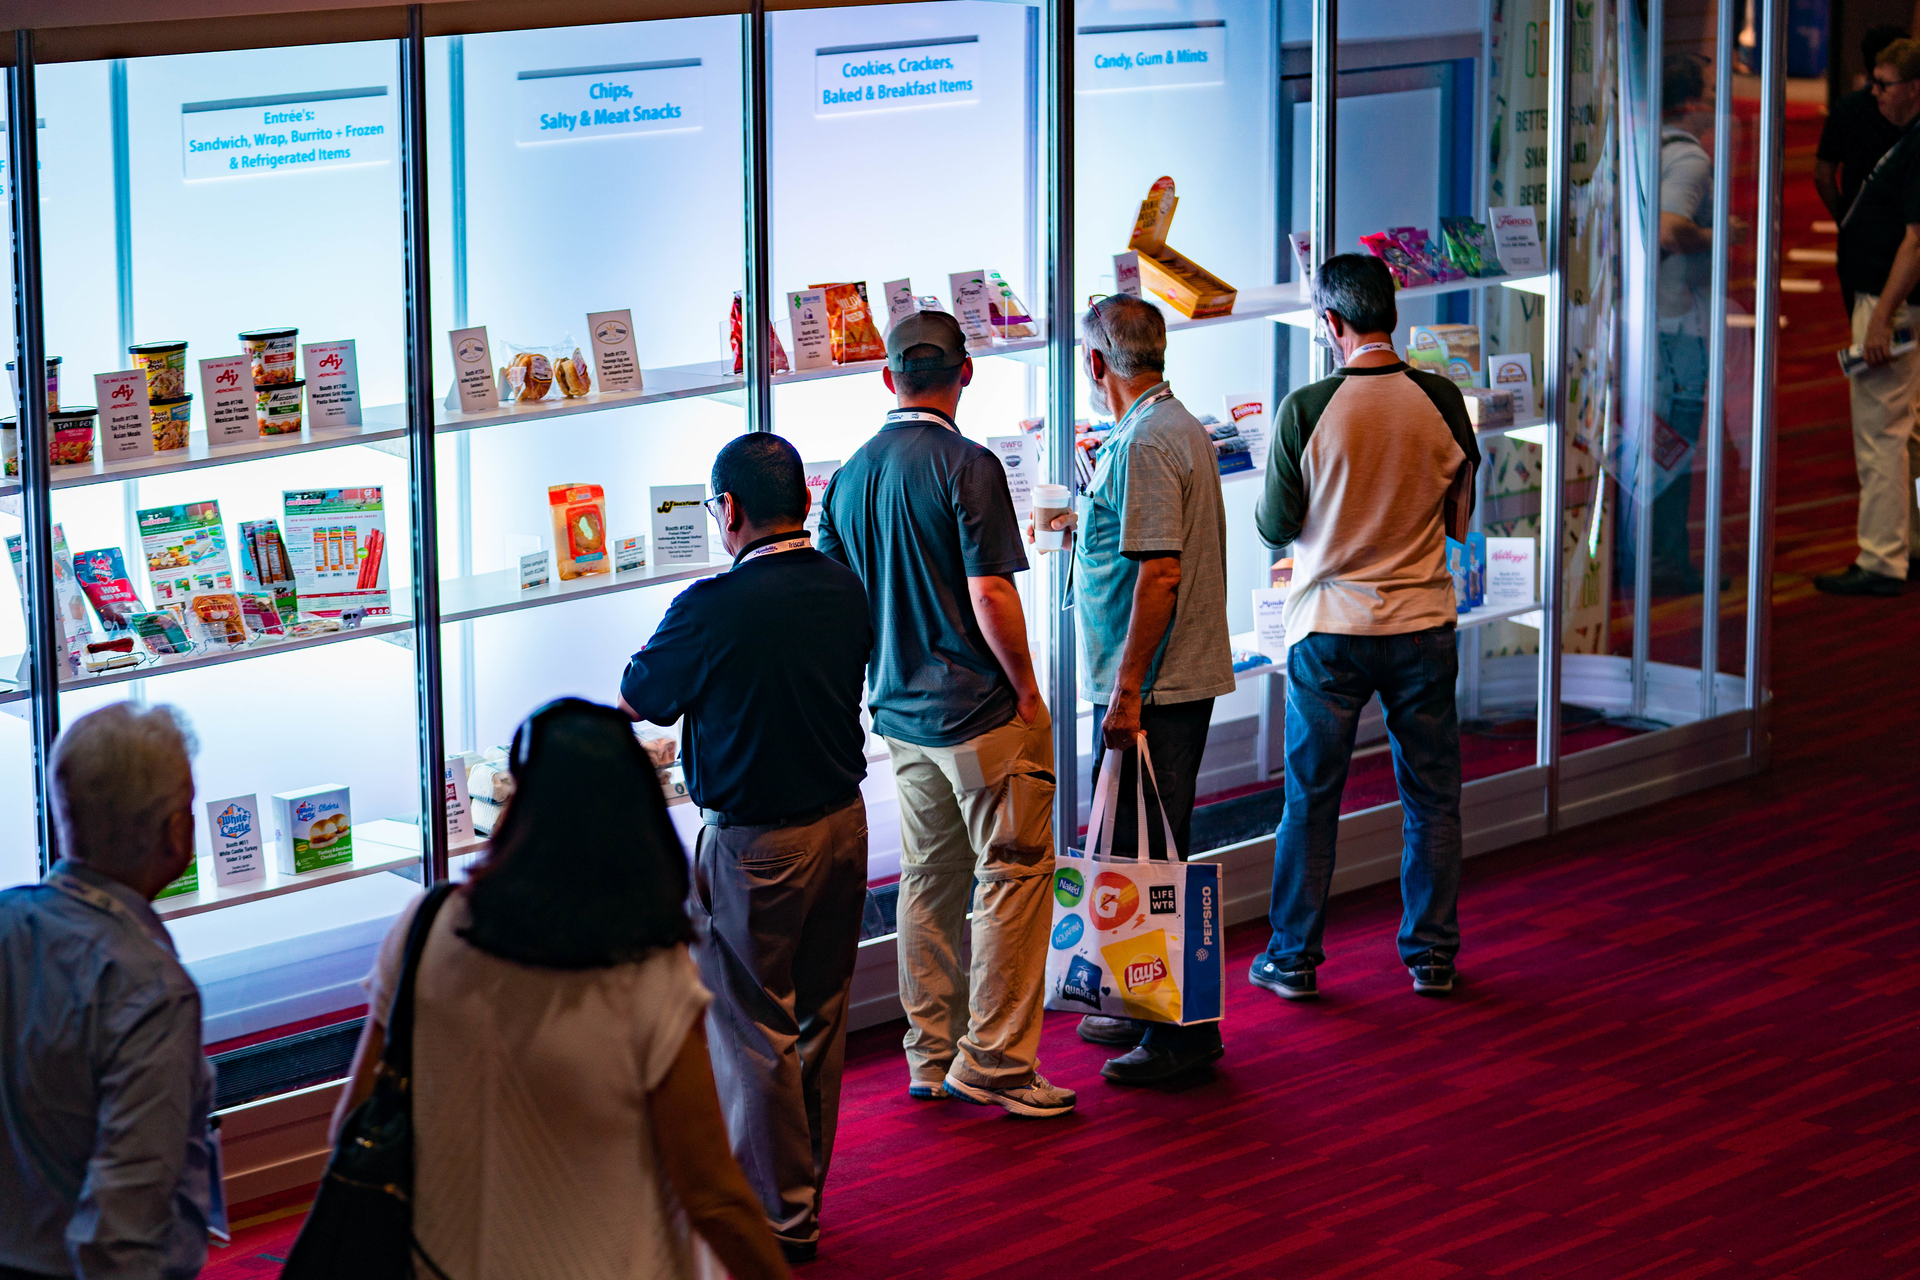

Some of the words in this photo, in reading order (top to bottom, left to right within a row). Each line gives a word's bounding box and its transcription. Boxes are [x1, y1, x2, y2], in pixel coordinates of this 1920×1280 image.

[842, 61, 895, 78] Cookies,
[898, 56, 954, 73] Crackers,
[1094, 53, 1133, 70] Candy,
[1136, 52, 1162, 66] Gum
[1165, 50, 1174, 64] &
[1176, 49, 1208, 63] Mints
[589, 82, 633, 102] Chips,
[823, 86, 862, 105] Baked
[865, 86, 875, 100] &
[878, 80, 936, 99] Breakfast
[939, 79, 973, 93] Items
[264, 109, 315, 125] Entrée's:
[540, 112, 577, 132] Salty
[580, 110, 591, 127] &
[594, 108, 630, 125] Meat
[633, 103, 681, 122] Snacks
[189, 135, 251, 153] Sandwich,
[253, 132, 288, 147] Wrap,
[291, 127, 332, 143] Burrito
[336, 129, 343, 138] +
[345, 124, 384, 138] Frozen
[229, 157, 238, 170] &
[241, 149, 316, 169] Refrigerated
[319, 147, 351, 160] Items
[127, 430, 141, 438] Meals
[1491, 549, 1529, 563] Kellogg's
[101, 585, 121, 594] HOT
[318, 802, 340, 813] Sliders
[222, 813, 248, 825] White
[221, 823, 250, 834] Castle
[244, 845, 258, 853] Turkey
[335, 844, 351, 852] Smoked
[336, 850, 352, 858] Sliders
[238, 853, 253, 861] 2-pack
[1059, 879, 1081, 896] Naked
[1151, 889, 1174, 899] LIFE
[1096, 885, 1121, 919] G
[1152, 900, 1175, 910] WTR
[1201, 886, 1213, 946] PEPSICO
[1055, 923, 1083, 946] AQUAFINA
[1128, 960, 1163, 989] Lay's
[1064, 984, 1097, 1002] QUAKER
